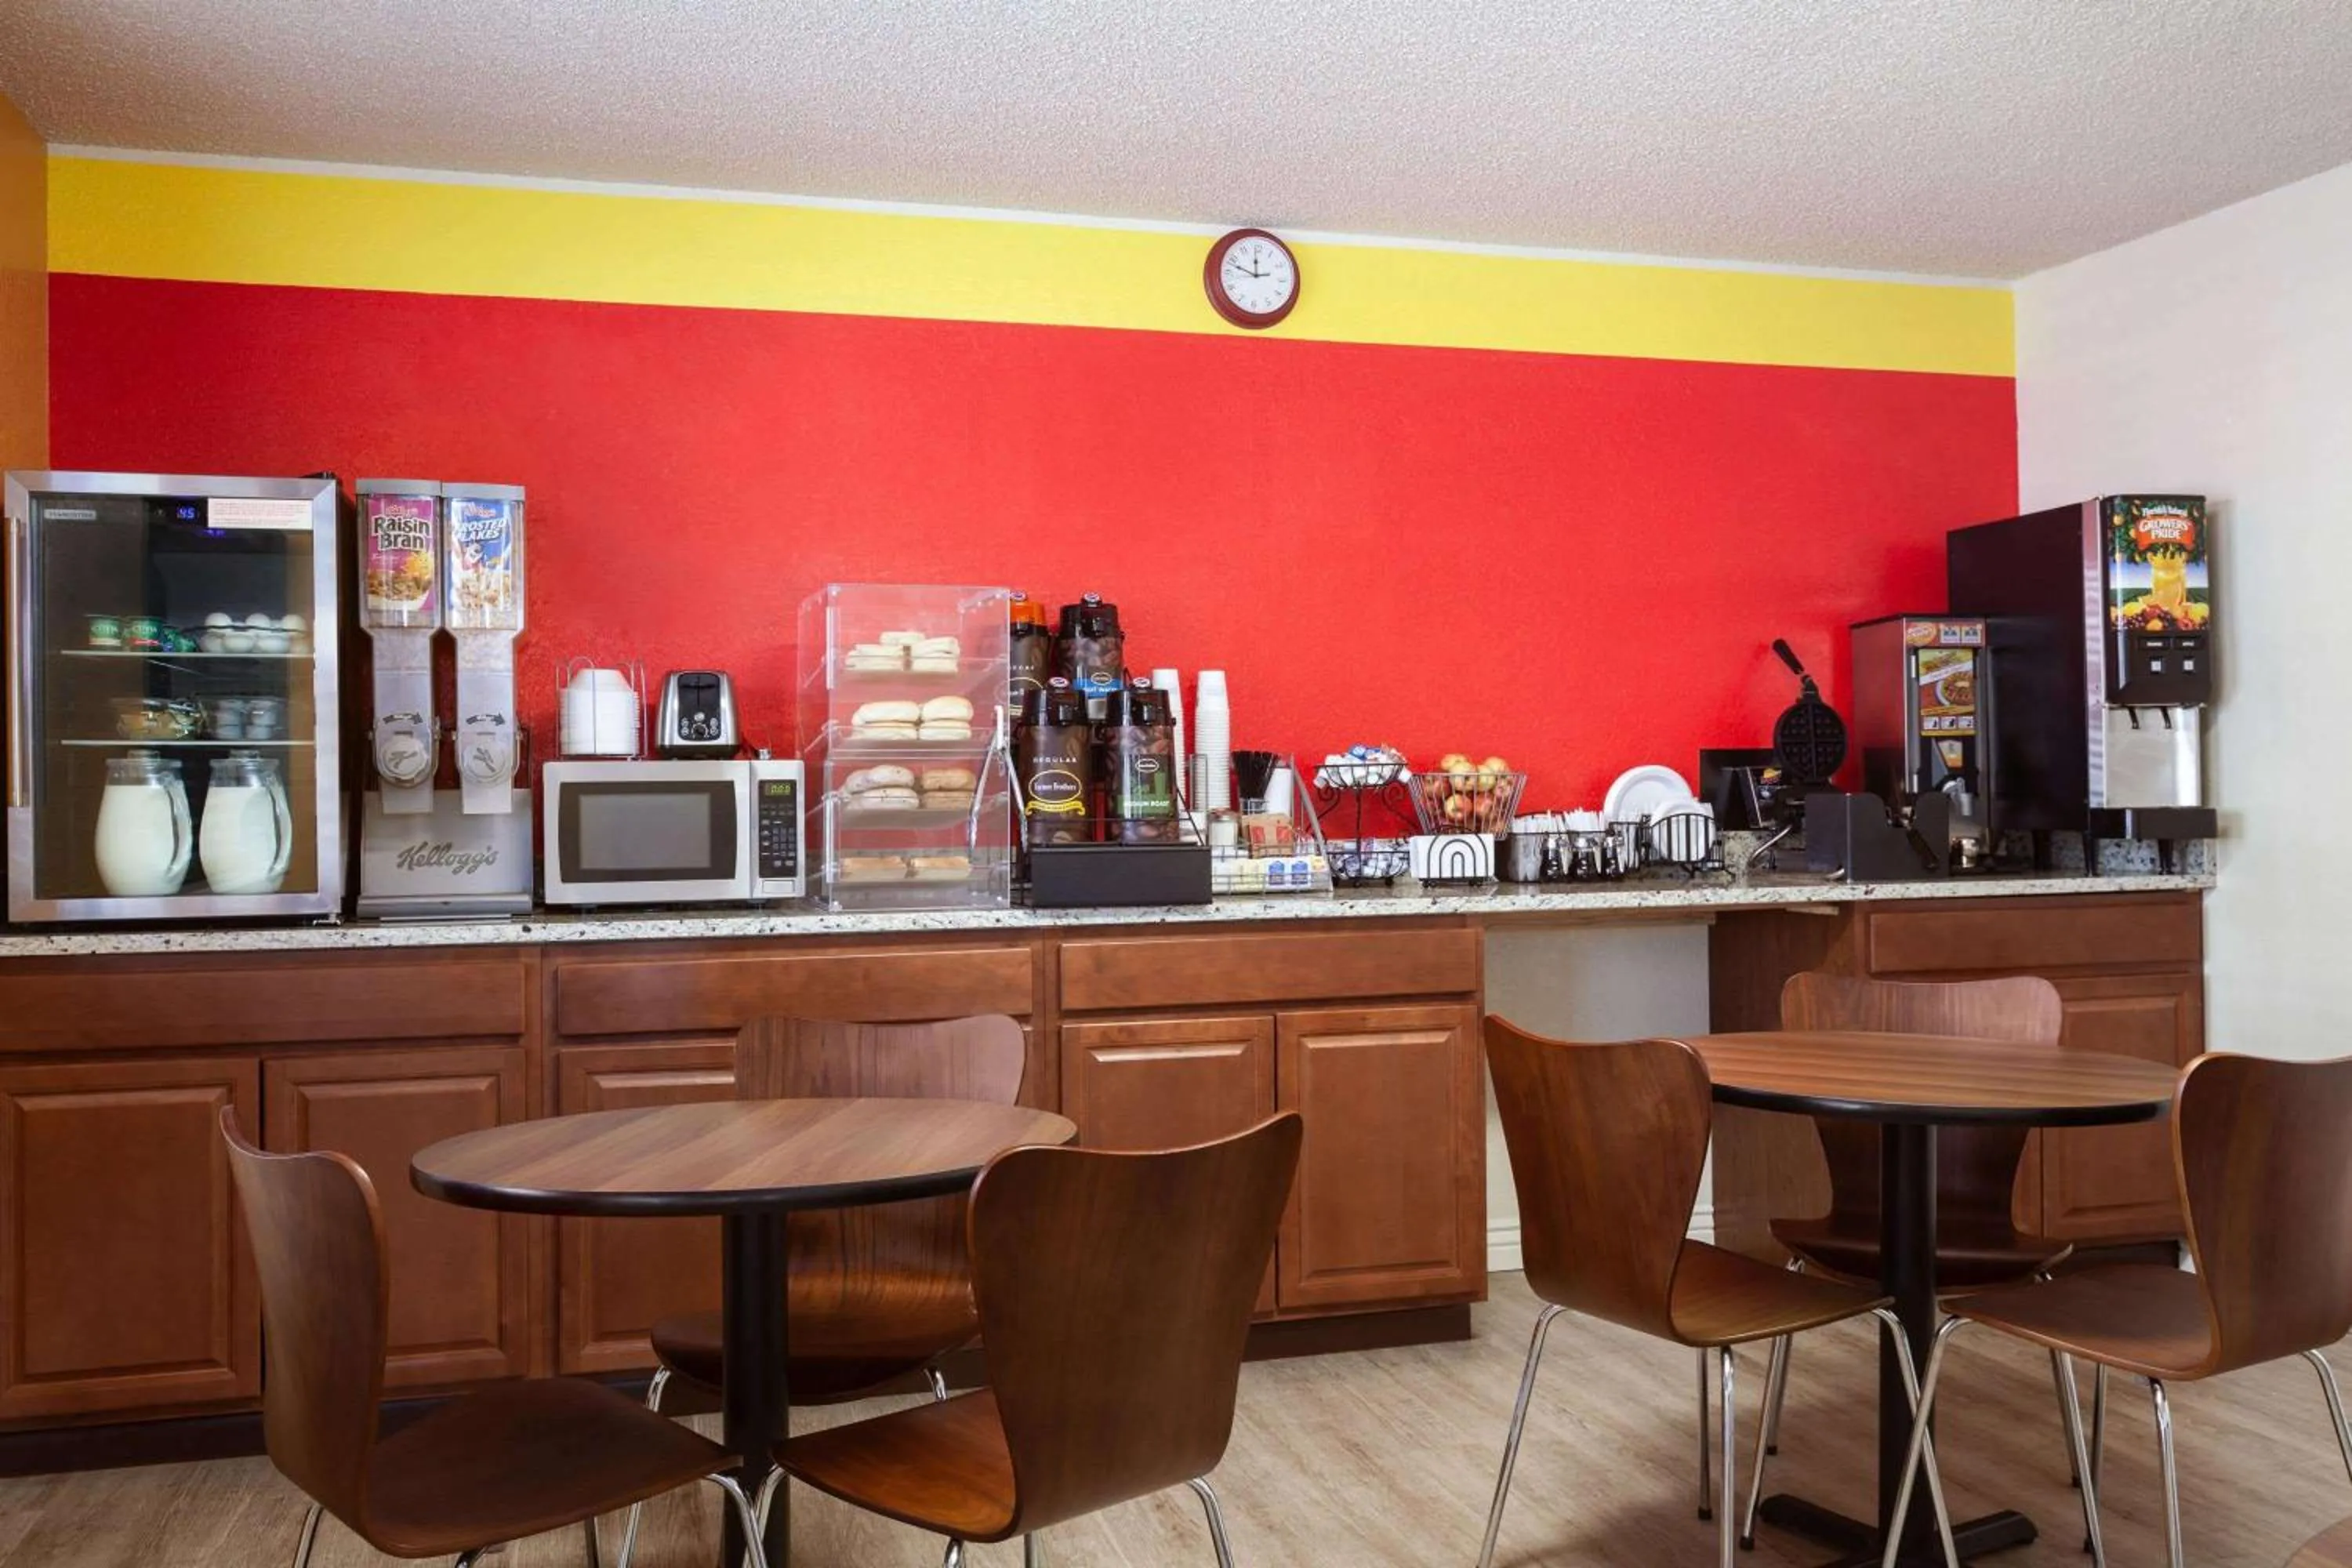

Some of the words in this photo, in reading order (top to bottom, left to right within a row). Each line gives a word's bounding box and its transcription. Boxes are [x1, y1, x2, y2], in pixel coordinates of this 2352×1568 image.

[372, 514, 432, 537] Raisin
[2151, 528, 2183, 540] PRIDE
[379, 532, 425, 550] Bran
[396, 840, 499, 875] Kellogg's
